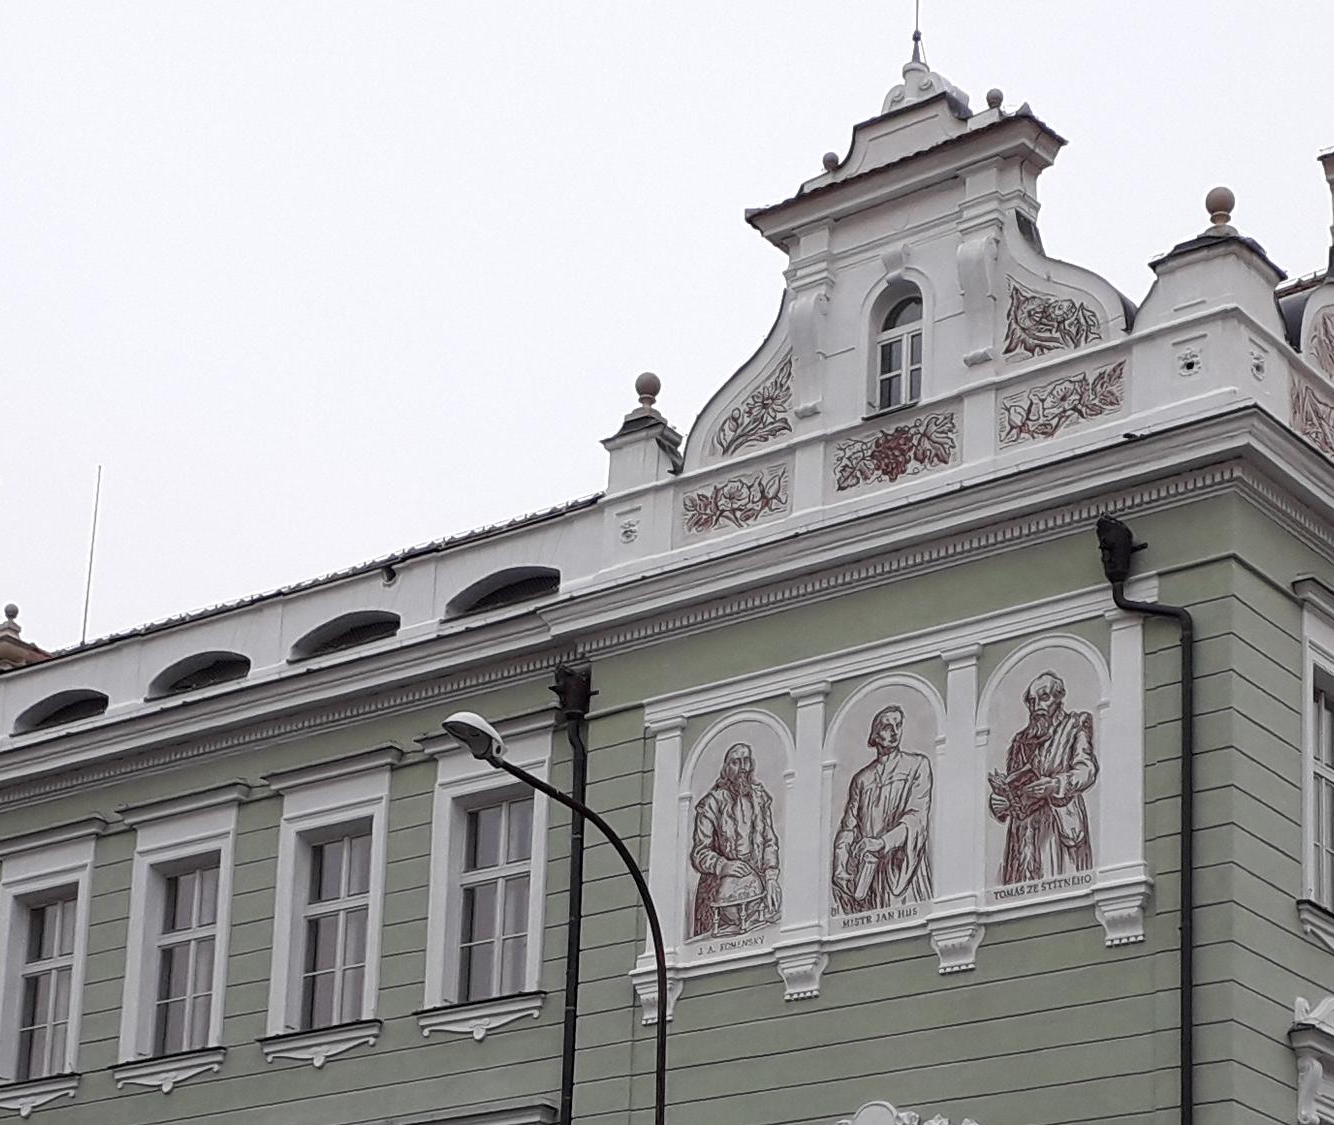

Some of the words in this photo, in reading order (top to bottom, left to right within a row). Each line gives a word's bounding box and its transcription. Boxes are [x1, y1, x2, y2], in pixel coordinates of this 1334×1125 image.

[842, 915, 872, 928] MISTR
[876, 911, 895, 923] JAN
[898, 907, 918, 919] HUS
